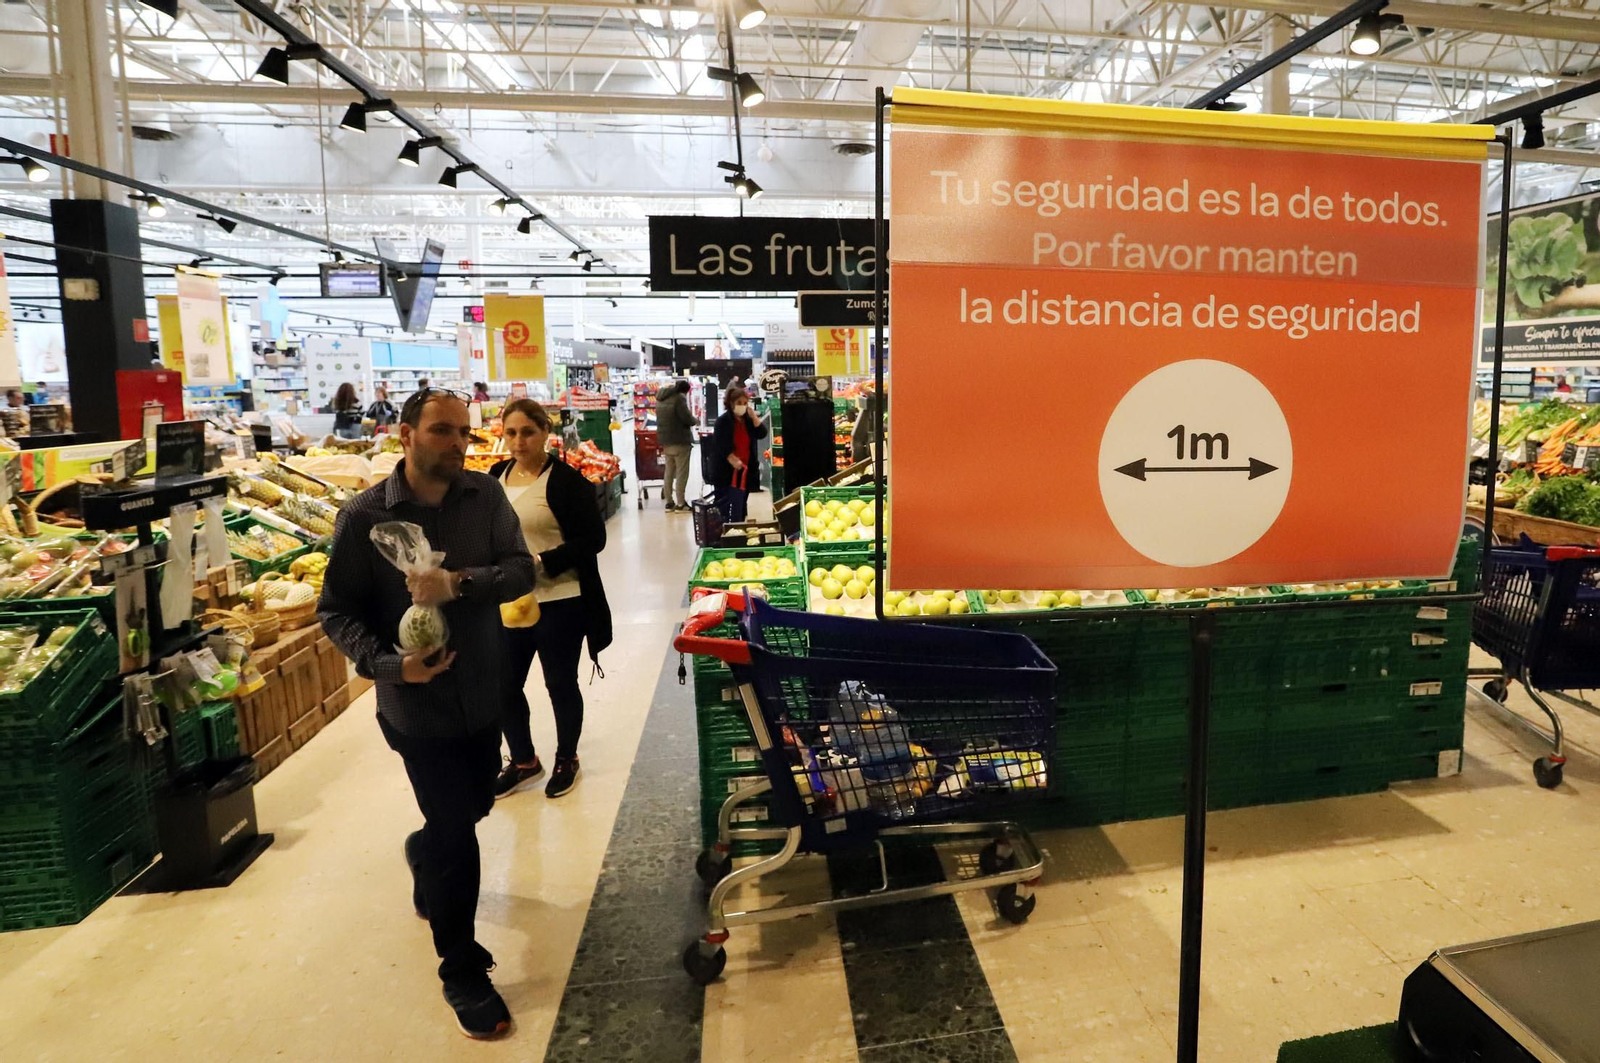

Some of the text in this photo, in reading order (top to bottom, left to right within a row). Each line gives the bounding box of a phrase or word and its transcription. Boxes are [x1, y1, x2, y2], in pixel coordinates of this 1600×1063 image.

[931, 170, 1448, 227] Tu seguridad es la de todos.
[670, 233, 753, 276] Las
[1032, 232, 1358, 276] Por favor manten
[960, 288, 1421, 340] la distancia de seguridad
[1166, 424, 1230, 460] 1m
[121, 497, 154, 511] GUANTES
